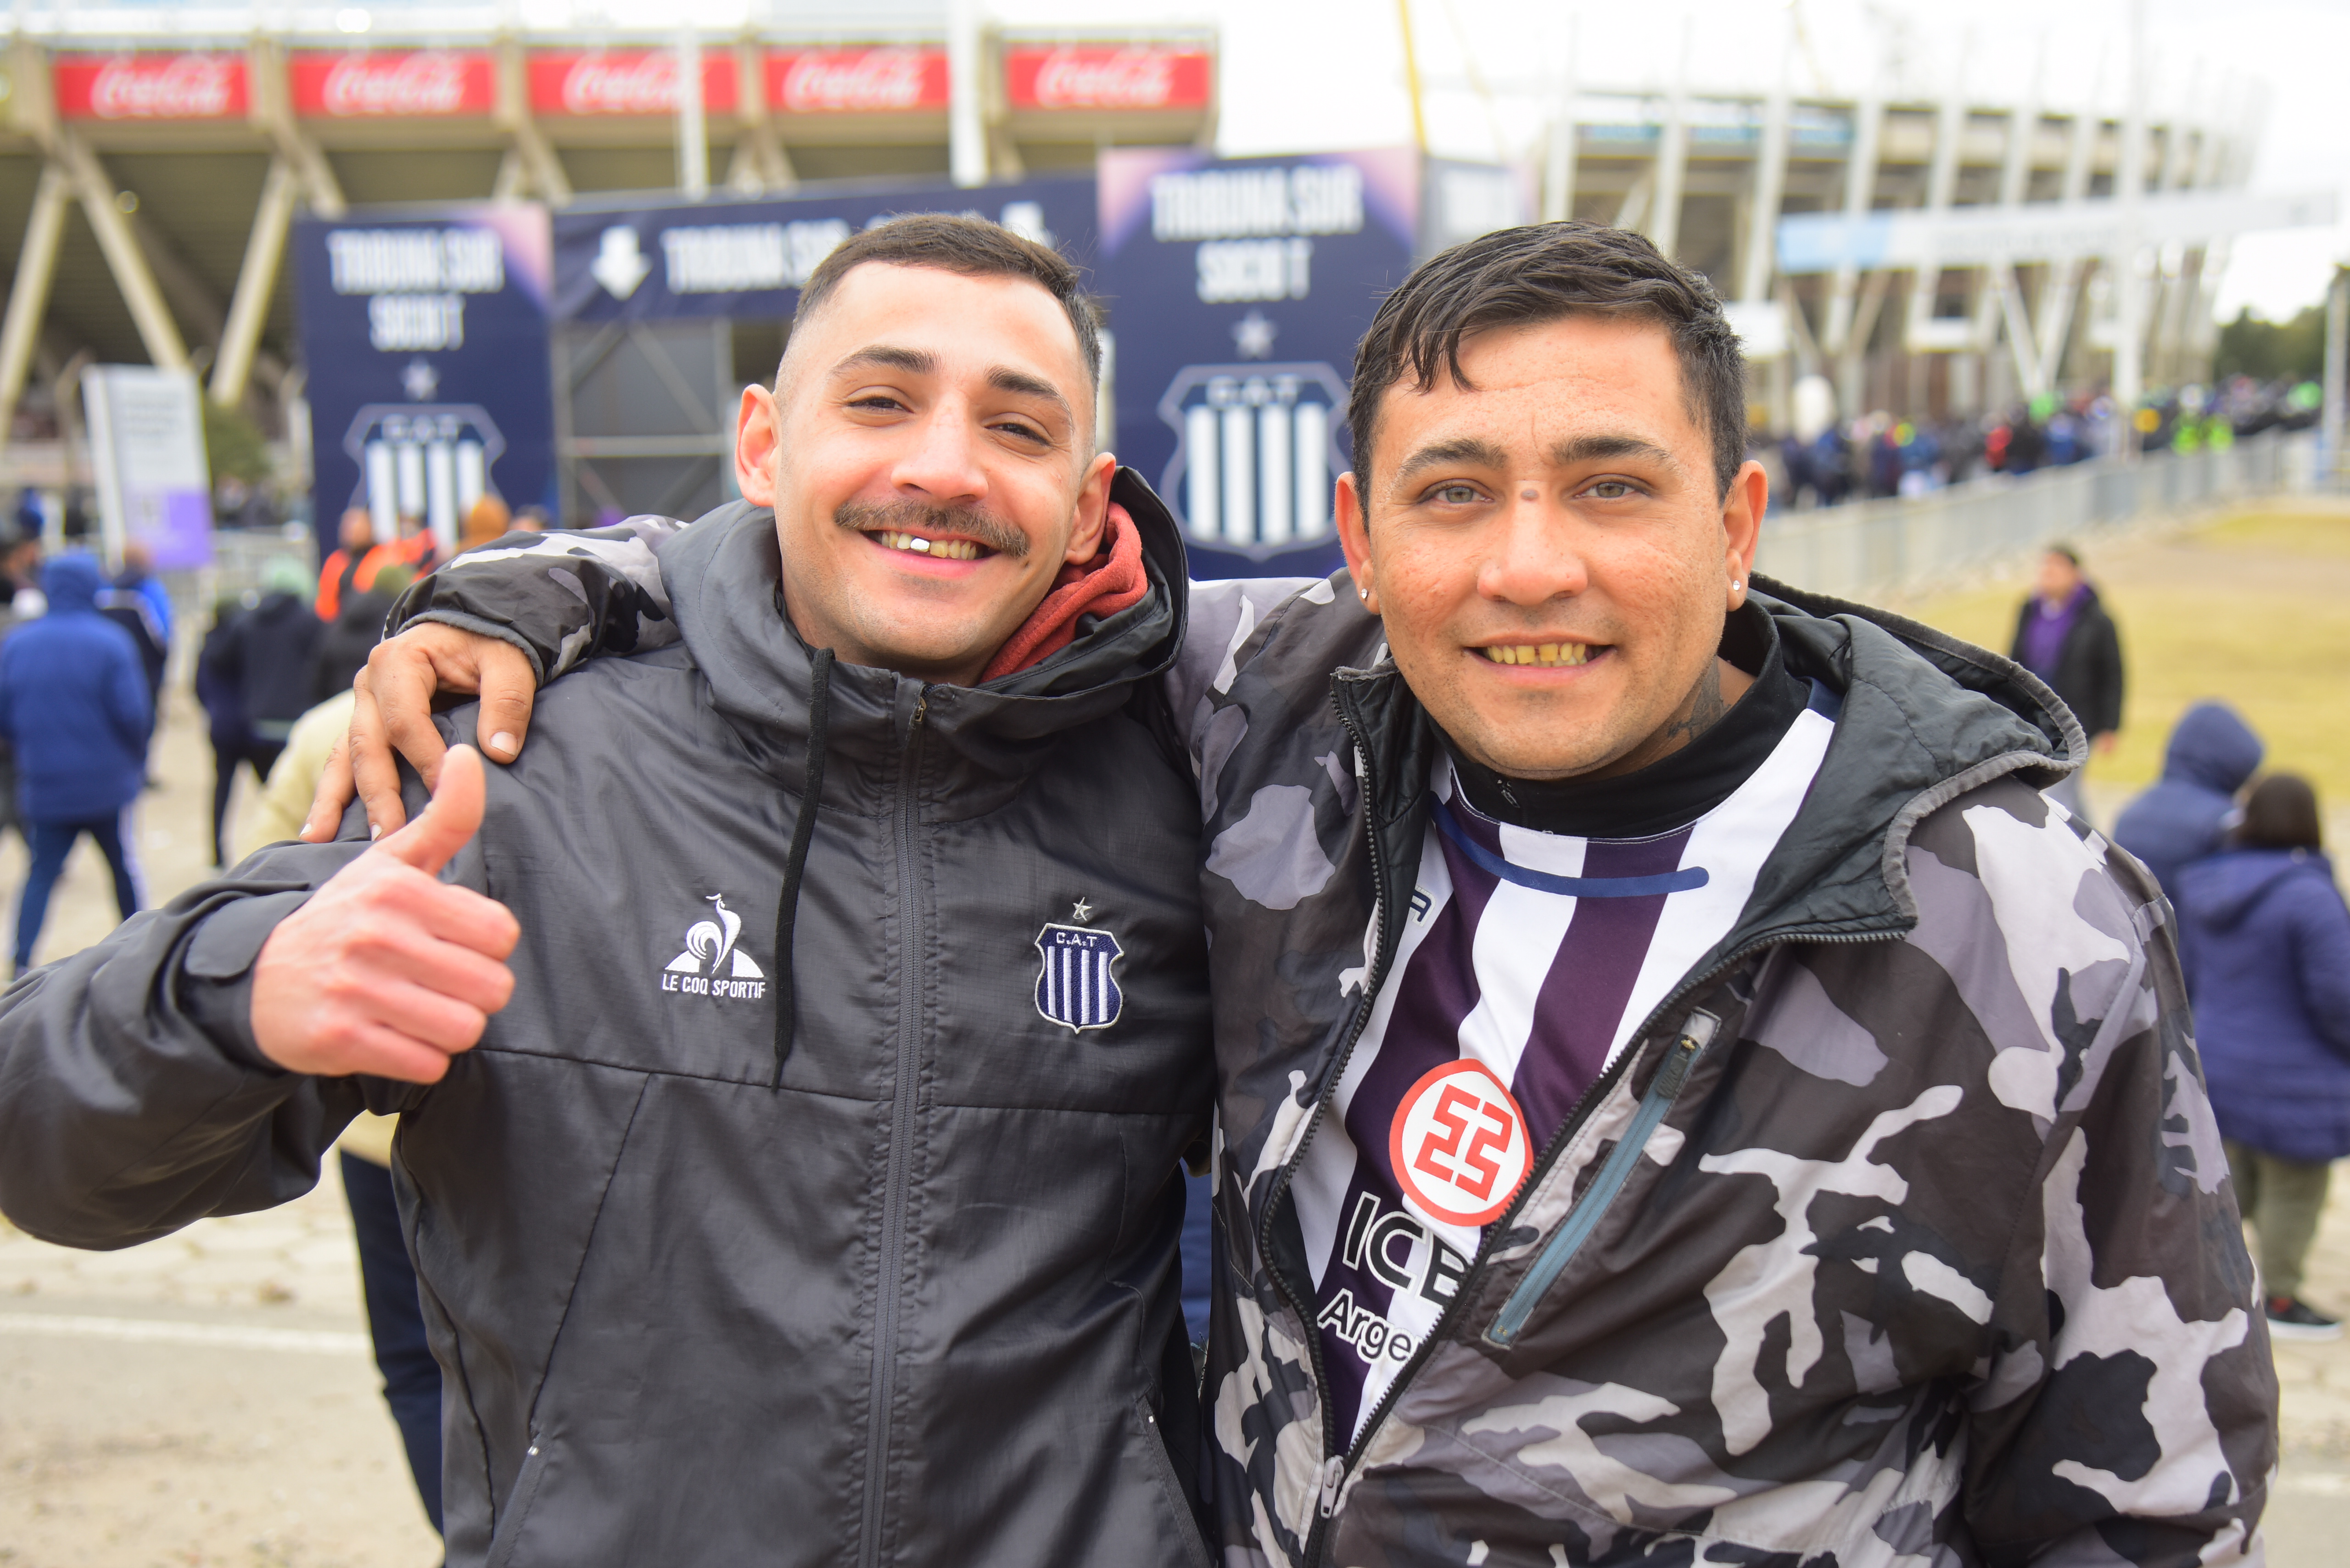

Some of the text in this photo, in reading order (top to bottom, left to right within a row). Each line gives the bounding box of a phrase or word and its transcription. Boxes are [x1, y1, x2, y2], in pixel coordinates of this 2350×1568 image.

[662, 974, 766, 999] LE COQ SPORTIF
[1317, 1288, 1423, 1364] Arge
